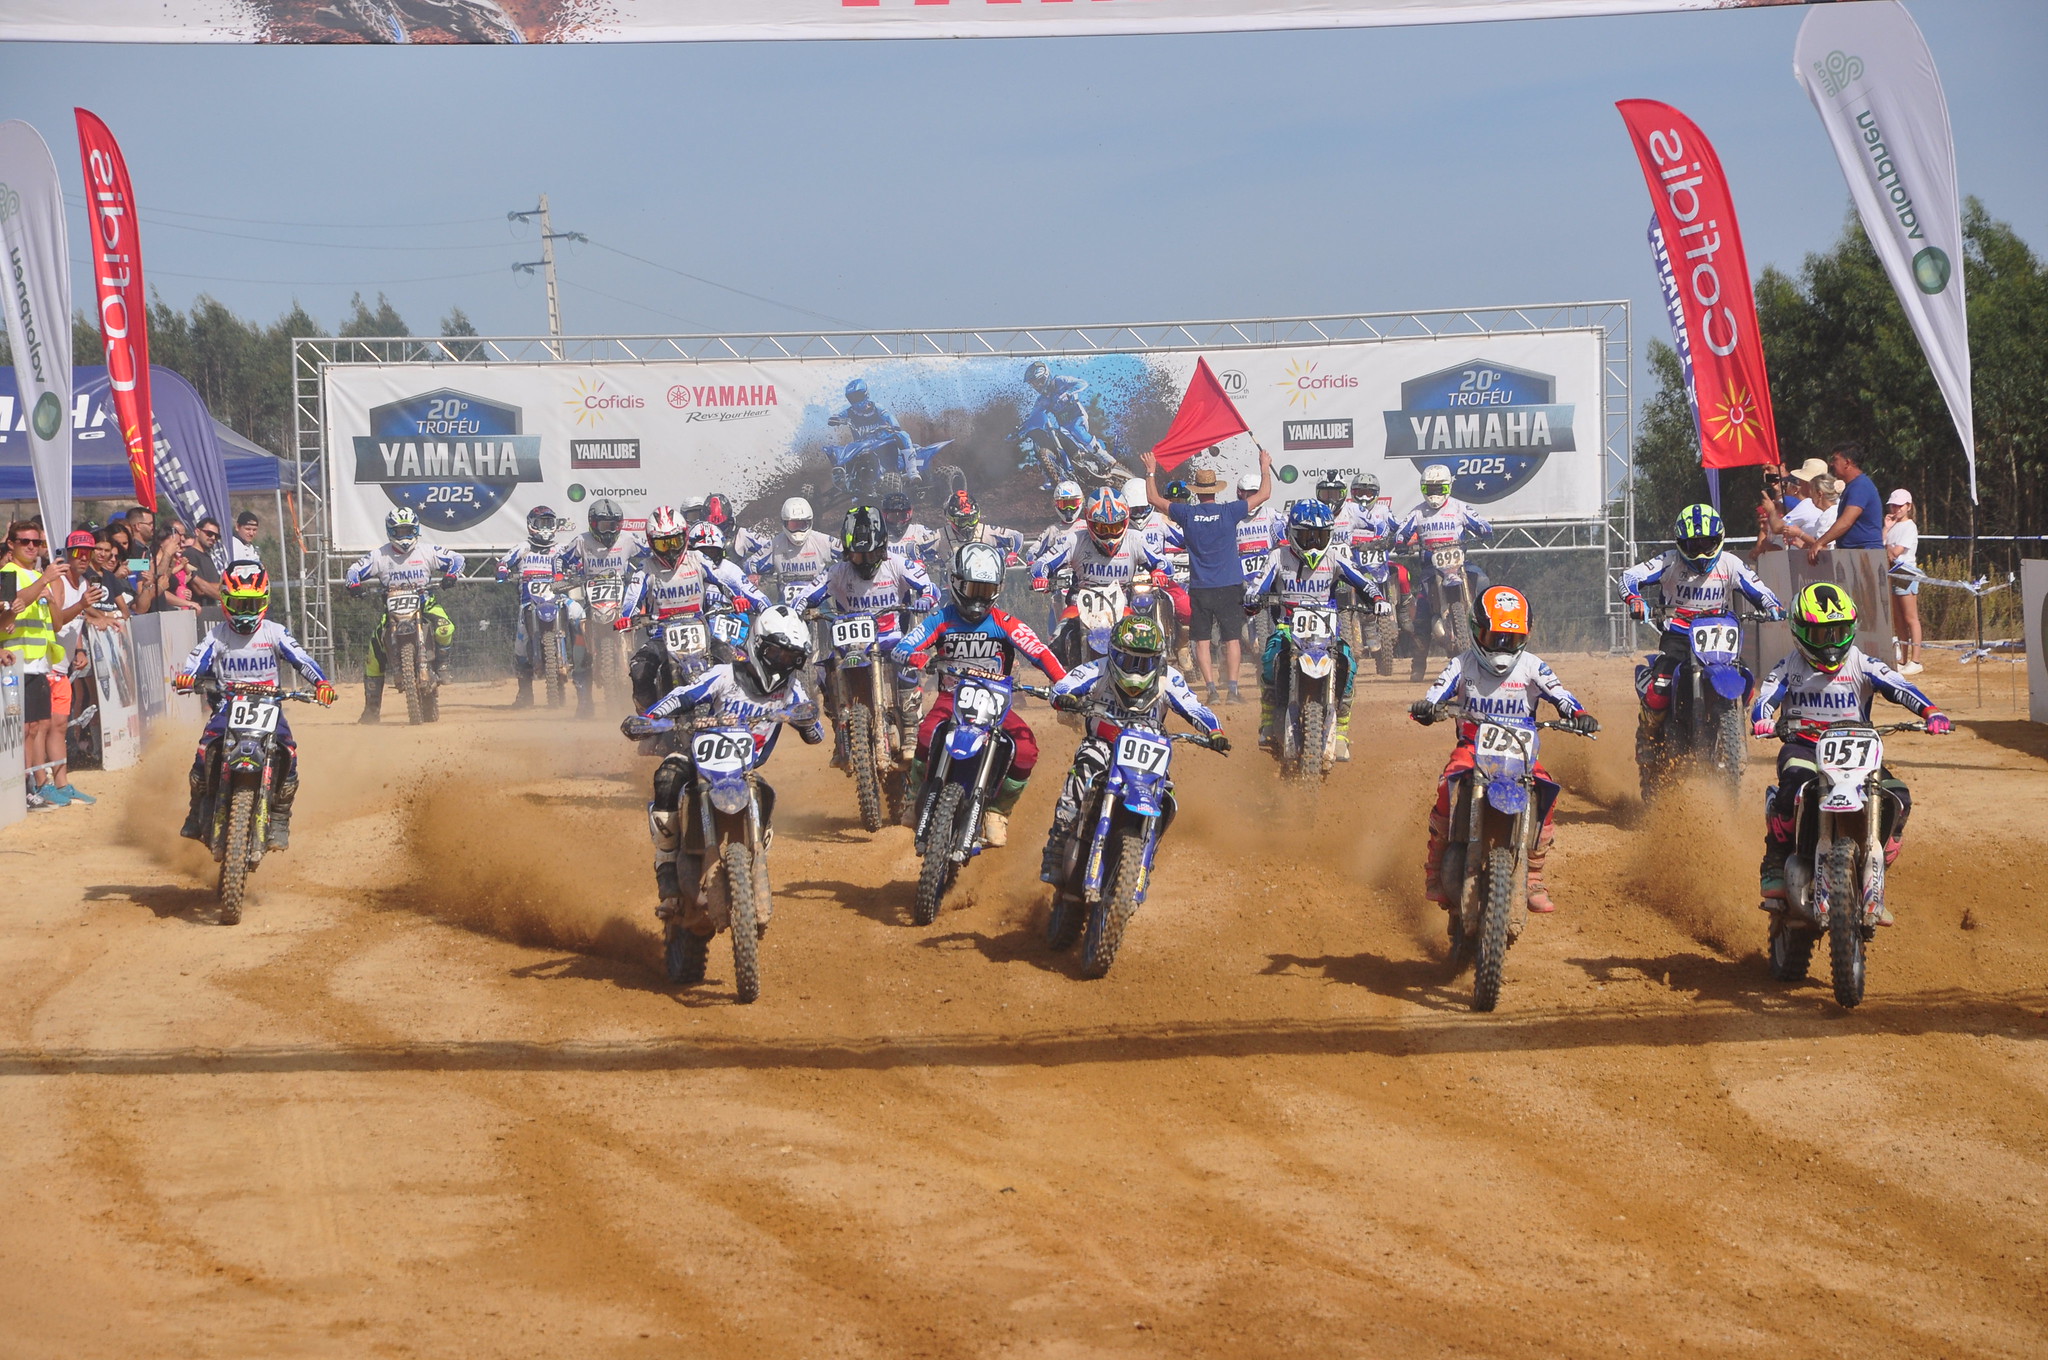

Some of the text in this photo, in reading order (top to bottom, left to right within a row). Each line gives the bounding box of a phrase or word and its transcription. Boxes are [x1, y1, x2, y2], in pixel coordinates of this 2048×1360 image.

[1223, 374, 1241, 390] 70
[1298, 374, 1358, 389] Cofidis
[585, 395, 645, 409] Cofidis
[693, 385, 778, 407] YAMAHA
[1448, 388, 1512, 406] TROFÉU
[685, 409, 770, 423] Revs Your Heart
[416, 418, 480, 435] TROFÉU
[1288, 423, 1349, 441] YAMALUBE
[1410, 411, 1552, 451] YAMAHA
[379, 441, 520, 477] YAMAHA
[575, 443, 636, 460] YAMALUBE
[1457, 458, 1506, 475] 2025
[426, 486, 474, 503] 2025
[590, 487, 647, 499] valorpneu
[1194, 514, 1220, 522] STAFF
[1422, 521, 1456, 532] YAMAHA
[888, 546, 905, 555] AMA
[1361, 551, 1385, 565] 878
[587, 557, 623, 568] YAMAHA
[781, 561, 817, 572] YAMAHA
[1082, 563, 1129, 577] YAMAHA
[389, 569, 424, 580] YAMAHA
[591, 585, 621, 601] 372
[653, 582, 701, 600] YAMAHA
[1282, 579, 1330, 593] YAMAHA
[1676, 585, 1725, 601] YAMAHA
[847, 593, 897, 609] YAMAHA
[837, 623, 870, 641] 966
[945, 633, 988, 642] OFFROAD
[1695, 627, 1737, 652] 979
[943, 641, 1002, 658] CAMP
[1011, 629, 1045, 655] CAMP
[221, 655, 276, 671] YAMAHA
[724, 698, 768, 718] YAMA
[1790, 692, 1857, 708] YAMAHA
[697, 737, 752, 763] 963
[1123, 740, 1166, 772] 967
[963, 801, 981, 848] Wingmotor
